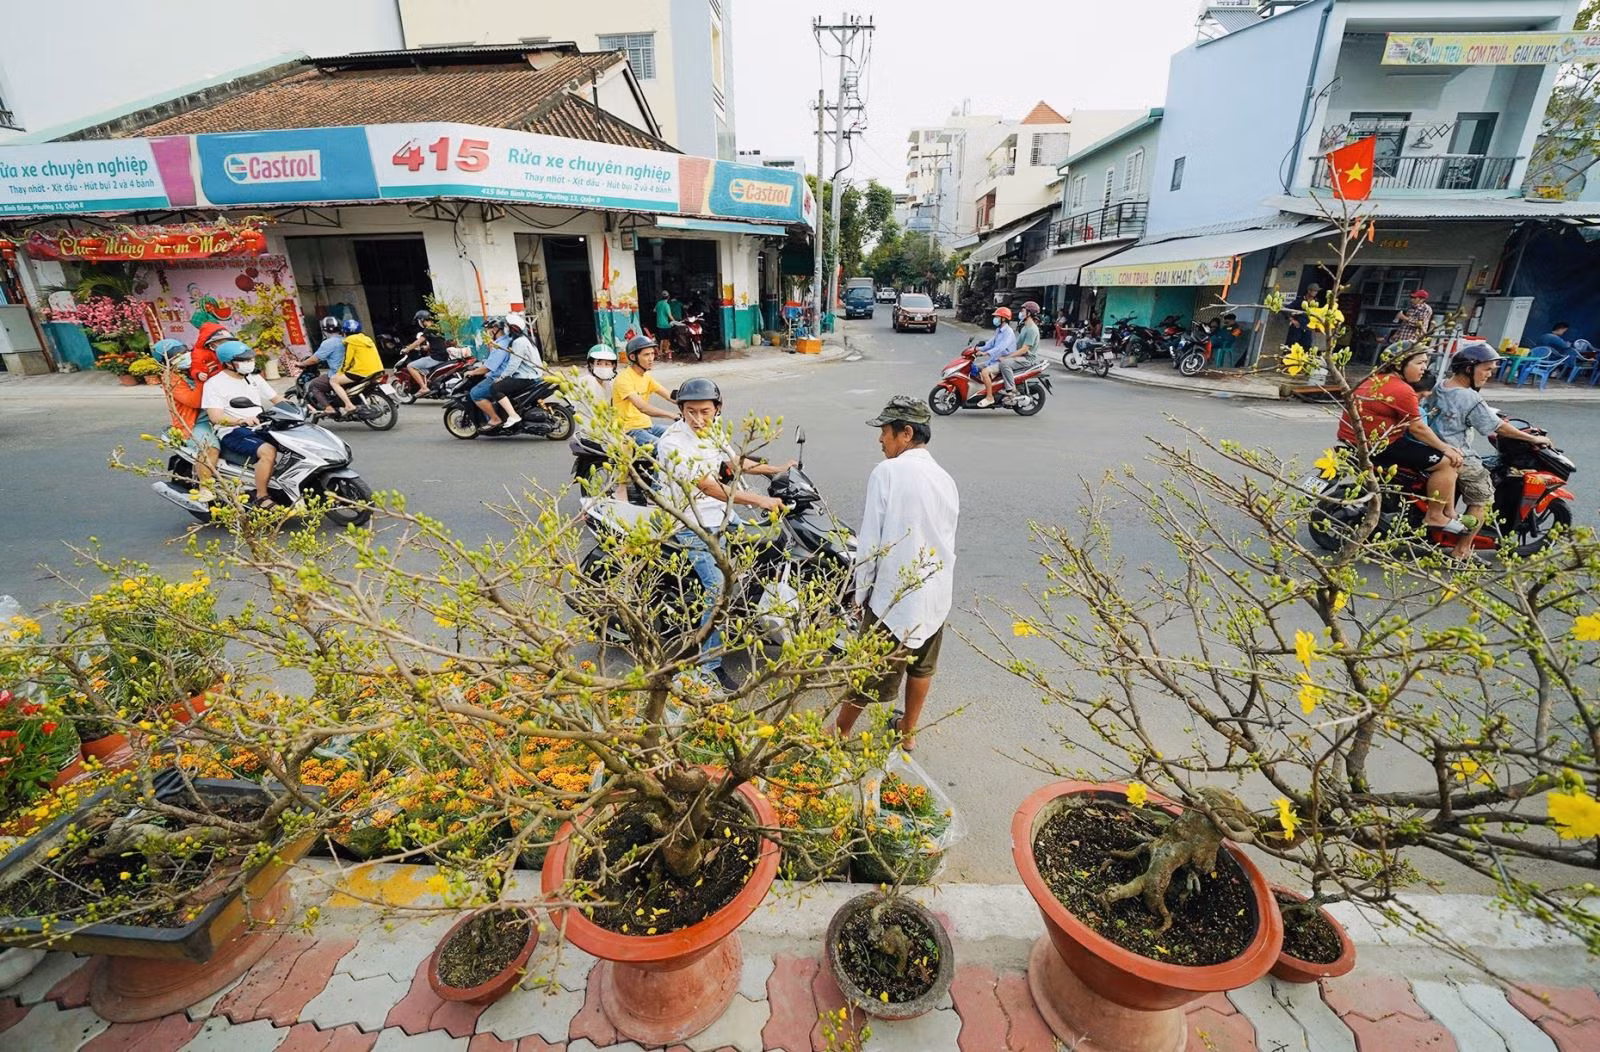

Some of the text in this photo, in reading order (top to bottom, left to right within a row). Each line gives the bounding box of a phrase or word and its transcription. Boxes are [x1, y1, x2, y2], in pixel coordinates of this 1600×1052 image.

[249, 154, 316, 179] Castrol
[391, 136, 490, 173] 415
[508, 147, 671, 183] Rửa xe chuyên nghiệp
[0, 155, 148, 180] ửa xe chuyên nghiệp
[524, 172, 545, 184] Thay
[9, 184, 27, 196] Thay
[113, 179, 119, 190] 2
[130, 178, 136, 188] 4
[745, 184, 790, 204] Castrol
